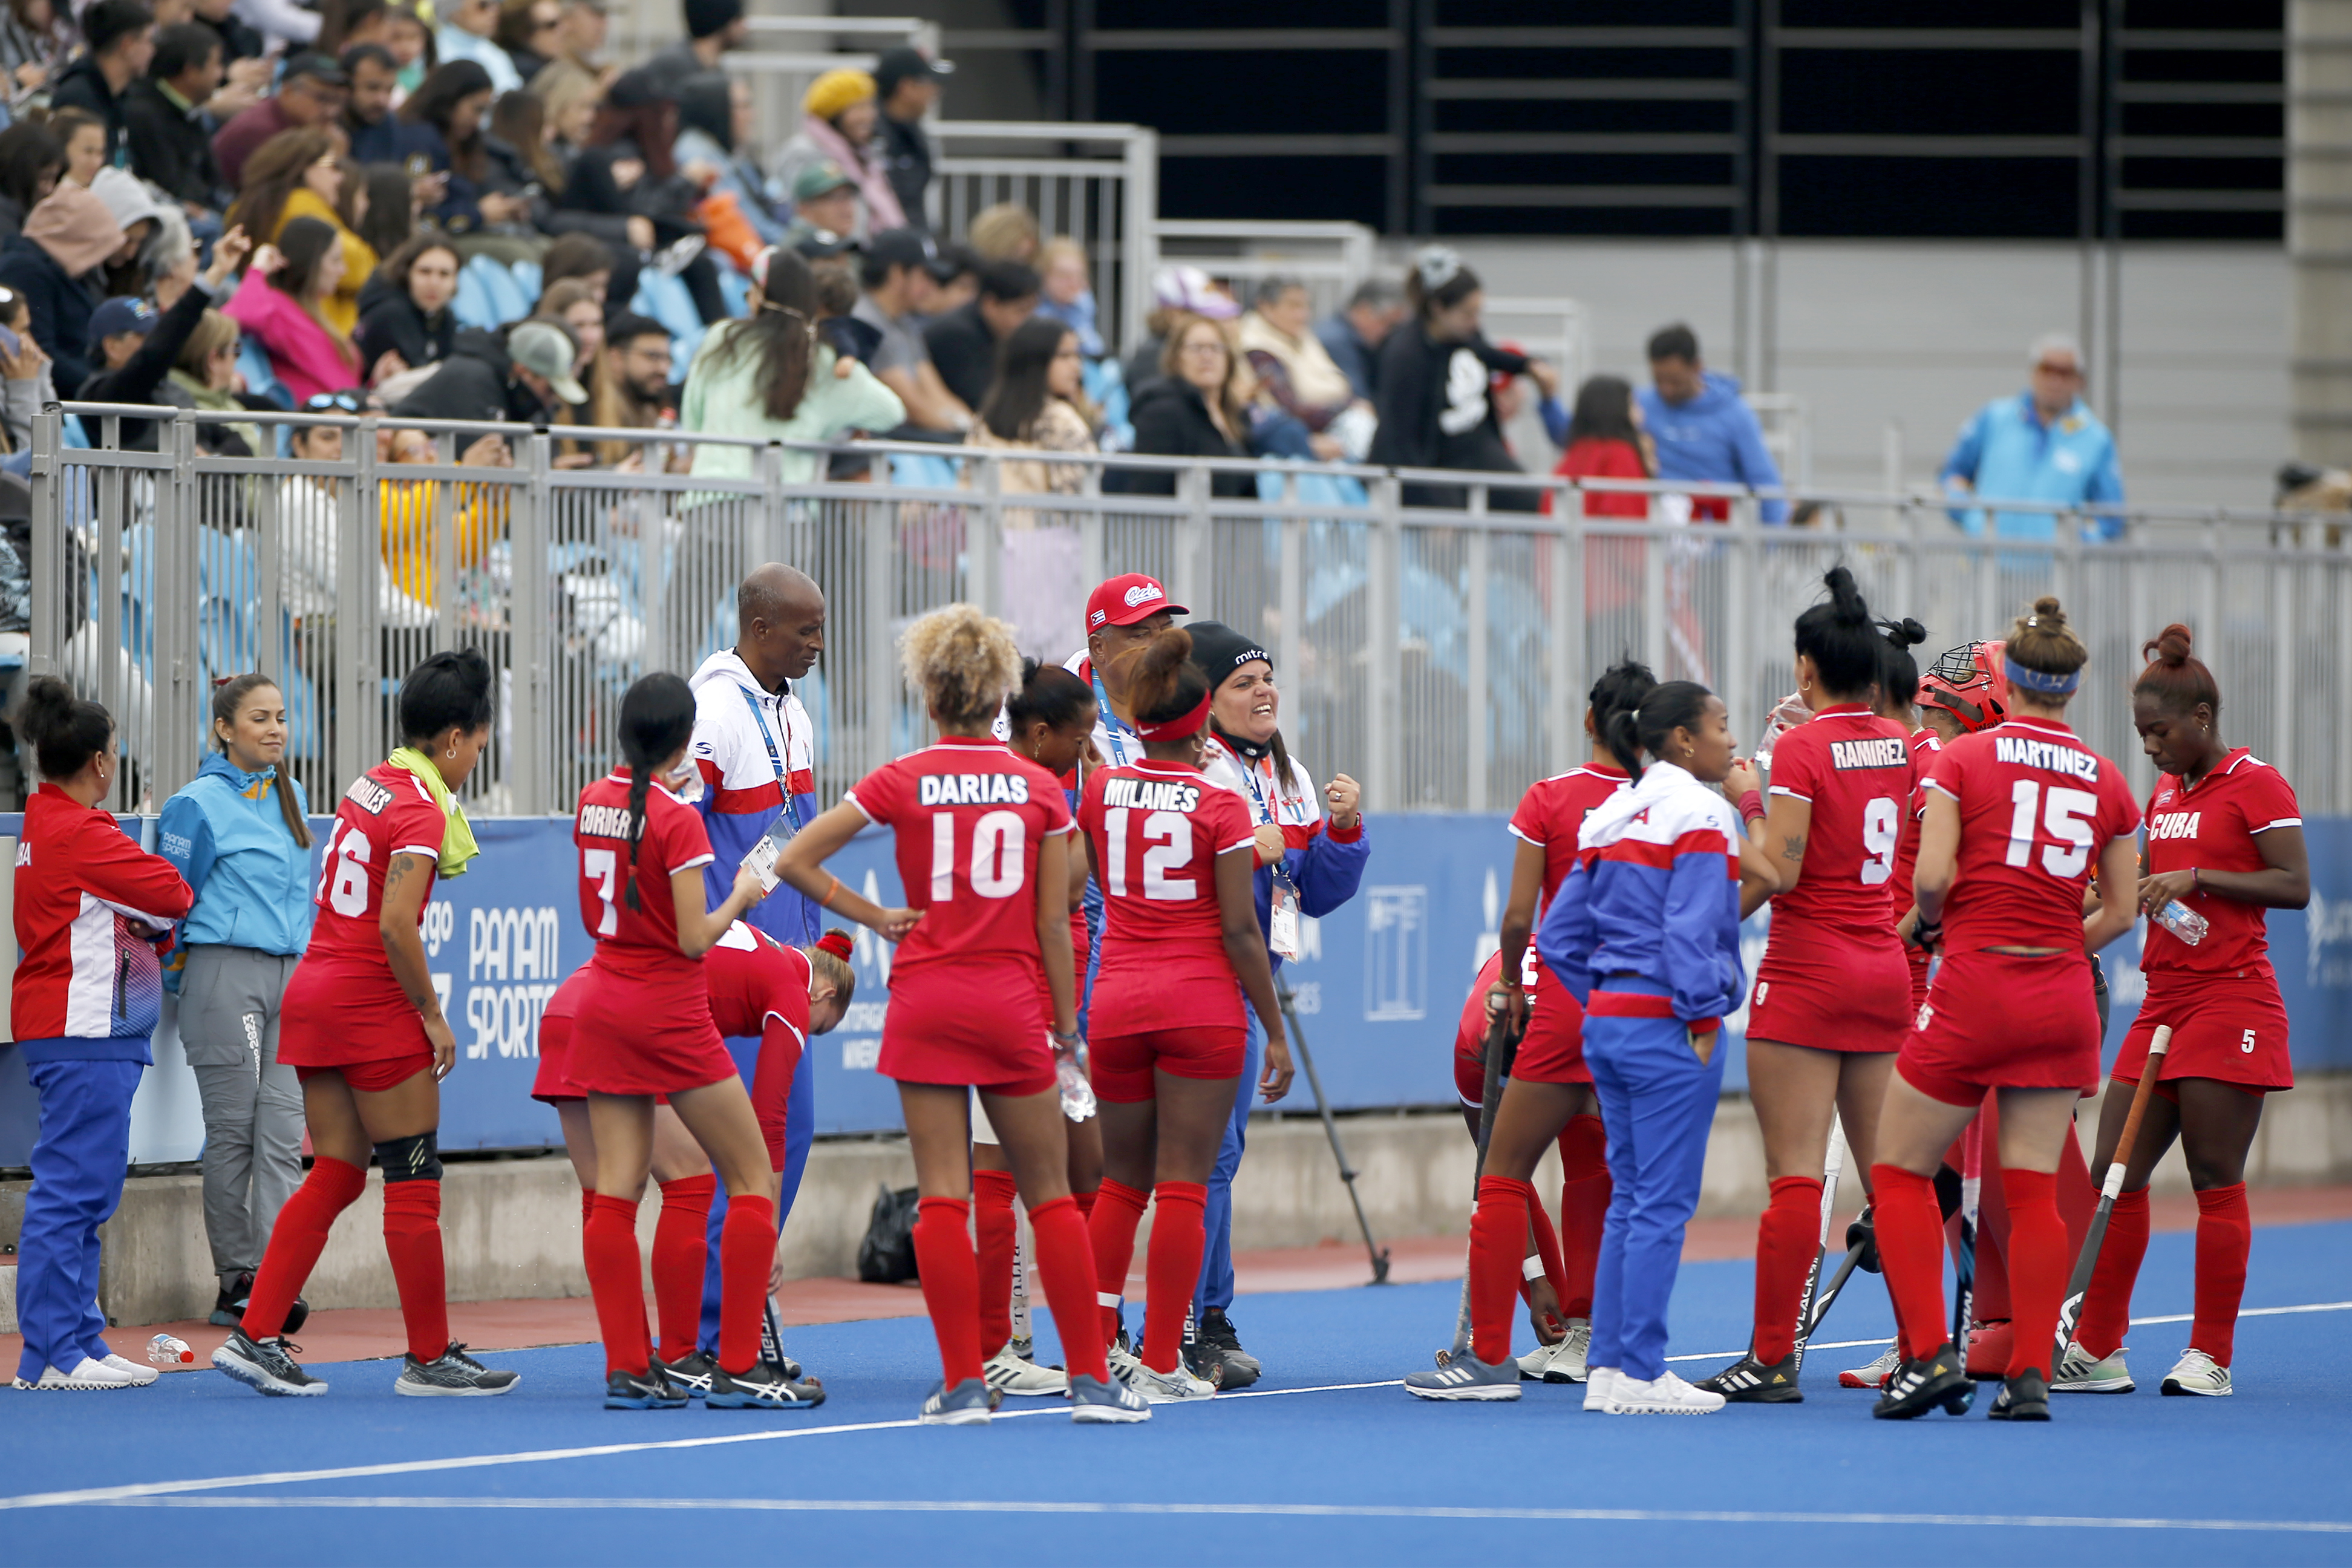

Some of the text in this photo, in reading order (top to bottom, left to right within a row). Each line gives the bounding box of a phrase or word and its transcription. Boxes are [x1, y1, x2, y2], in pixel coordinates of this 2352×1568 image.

[1124, 583, 1163, 607] Cuba
[1235, 649, 1269, 665] mitre
[1831, 738, 1907, 768] RAMIREZ
[1996, 737, 2097, 783] MARTINEZ
[921, 774, 1028, 805] DARIAS
[1103, 779, 1200, 813] MILANÉS
[163, 831, 191, 849] PANAM
[1860, 797, 1899, 885] 9
[2005, 779, 2098, 878] 15
[2149, 812, 2201, 841] CUBA
[162, 841, 191, 859] SPORTS
[931, 811, 1025, 902] 10
[1105, 808, 1198, 900] 12
[316, 817, 371, 918] 16
[584, 848, 618, 936] 7
[469, 906, 559, 981] PANAM
[1756, 982, 1769, 1005] 9
[2241, 1029, 2256, 1053] 5
